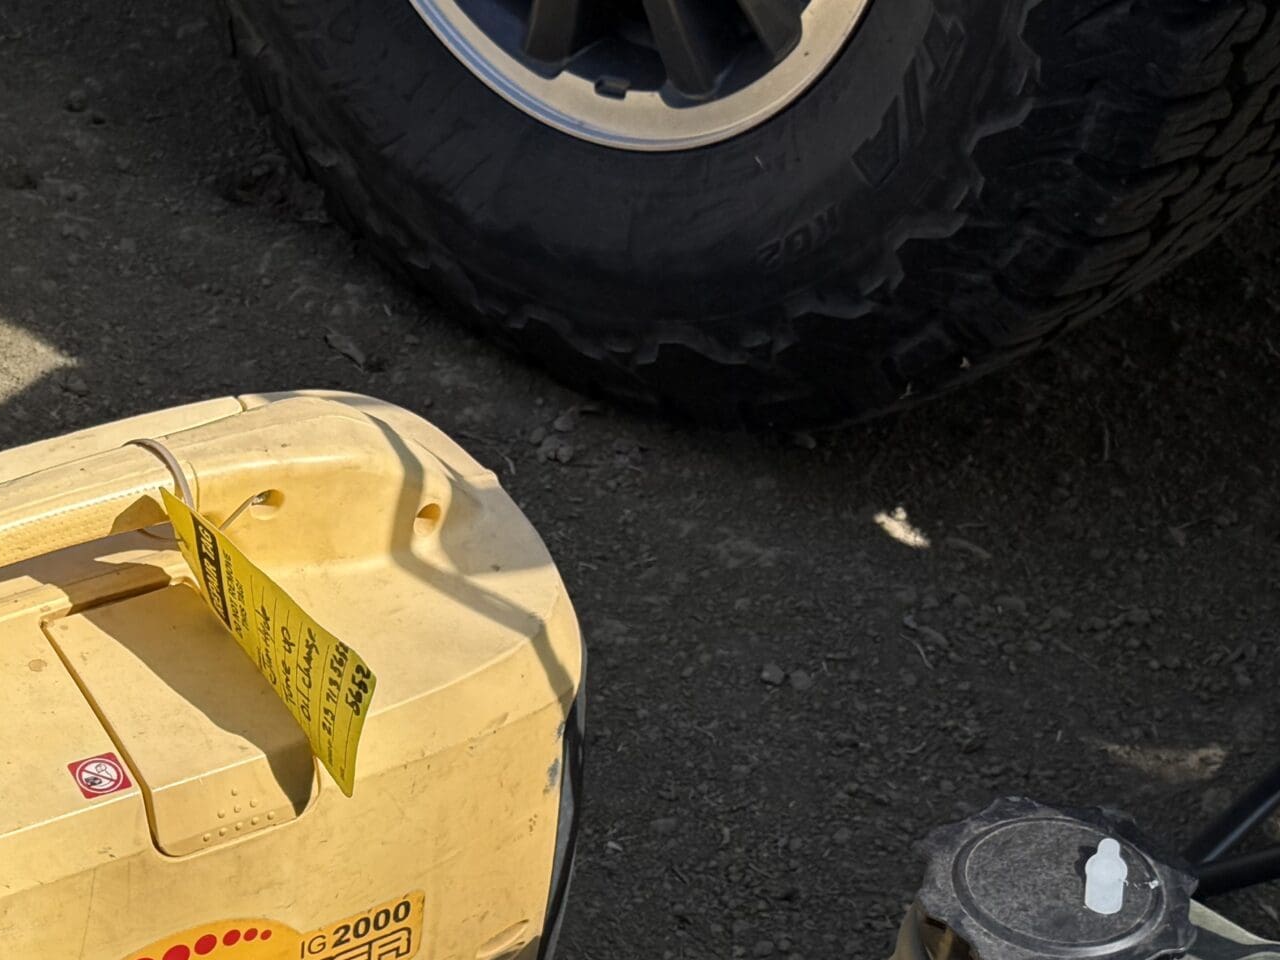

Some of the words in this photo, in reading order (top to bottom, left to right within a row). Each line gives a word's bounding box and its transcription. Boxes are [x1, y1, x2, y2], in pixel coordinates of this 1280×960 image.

[198, 525, 215, 560] TAG
[204, 558, 225, 619] REPAIR
[223, 549, 236, 599] REMOVE
[230, 596, 239, 622] NOT
[345, 663, 372, 717] 5652
[301, 935, 326, 959] IG
[332, 901, 410, 948] 2000
